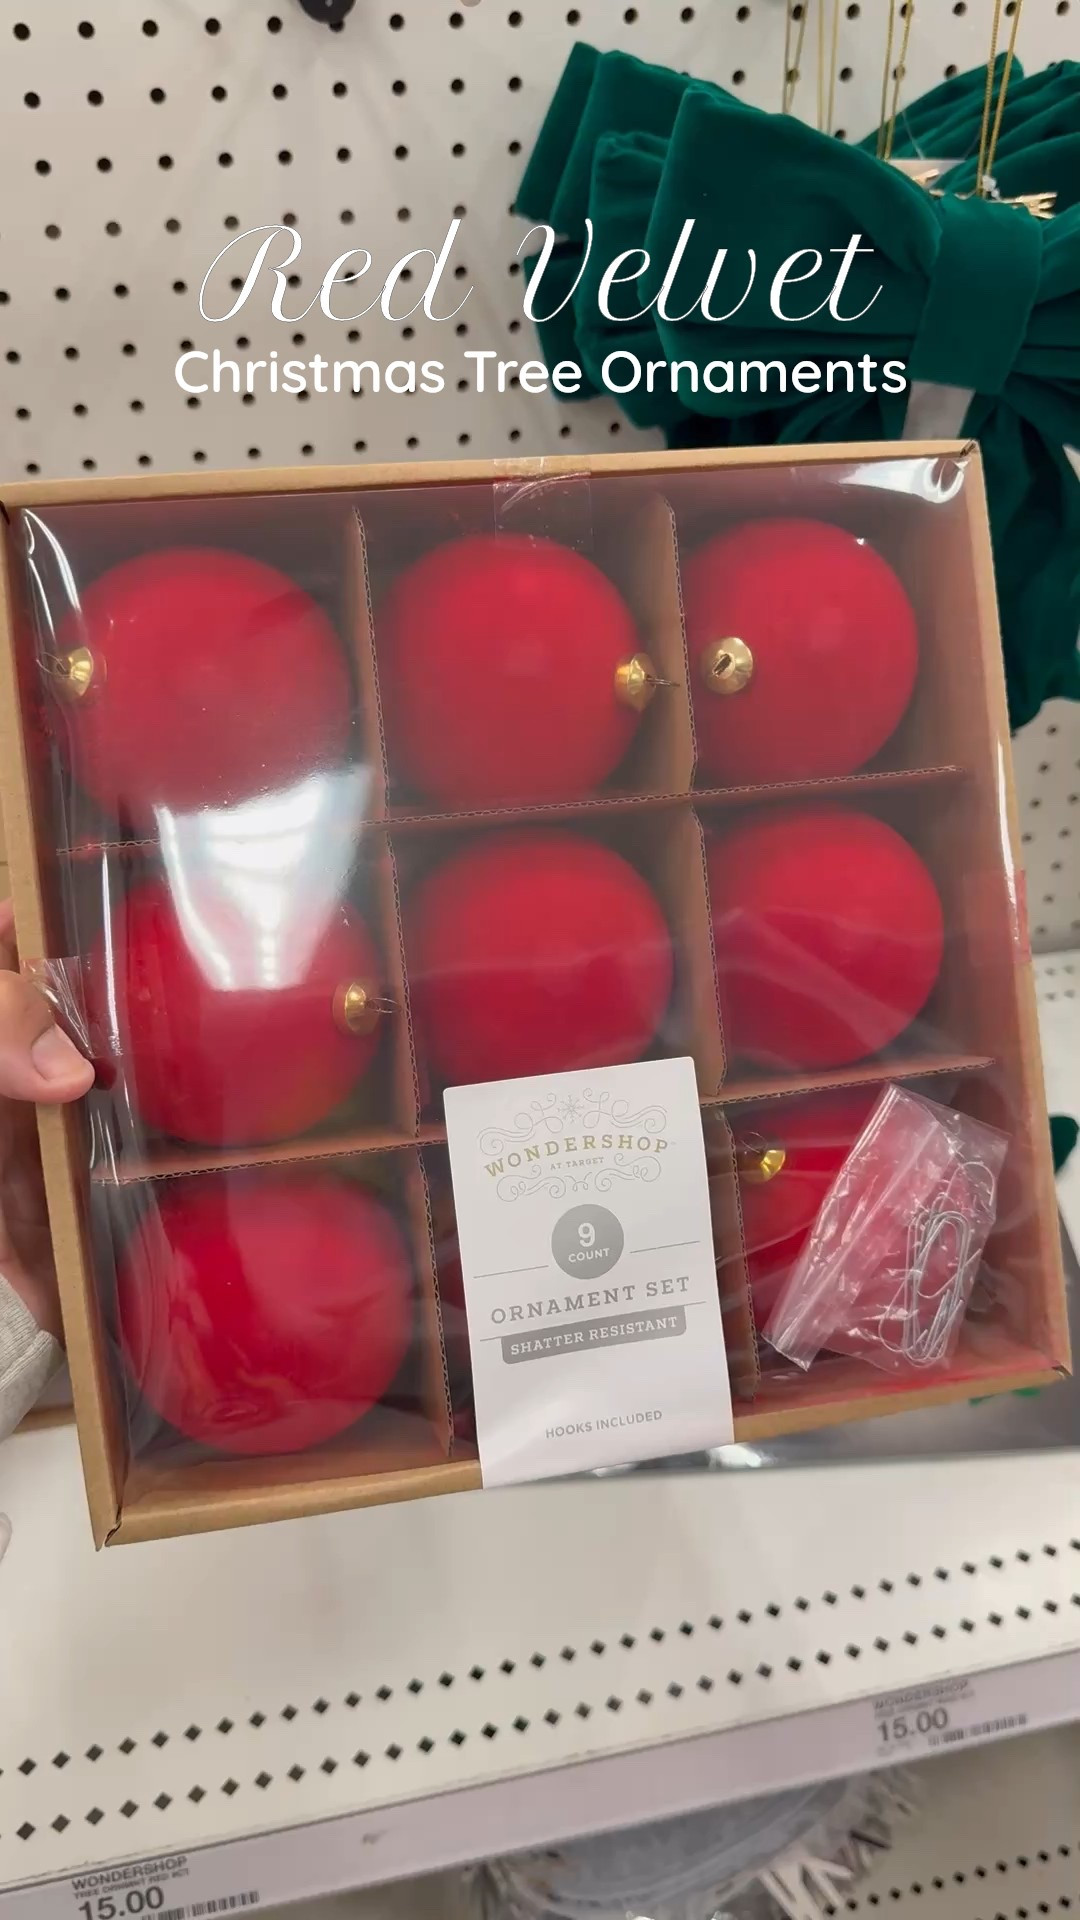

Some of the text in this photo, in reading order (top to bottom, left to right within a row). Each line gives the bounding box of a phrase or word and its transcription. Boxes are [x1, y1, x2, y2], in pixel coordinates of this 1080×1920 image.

[484, 1134, 669, 1178] WONDERSHOP
[549, 1156, 605, 1171] AT TARGET
[577, 1222, 597, 1248] 9
[568, 1247, 611, 1263] COUNT
[491, 1276, 691, 1325] ORNAMENT SET
[510, 1316, 679, 1356] SHATTER RESISTANT
[545, 1410, 664, 1439] HOOKS INCLUDED
[877, 1707, 949, 1742] 15.00
[71, 1855, 188, 1891] WONDERSHOP
[78, 1885, 165, 1920] 15.00
